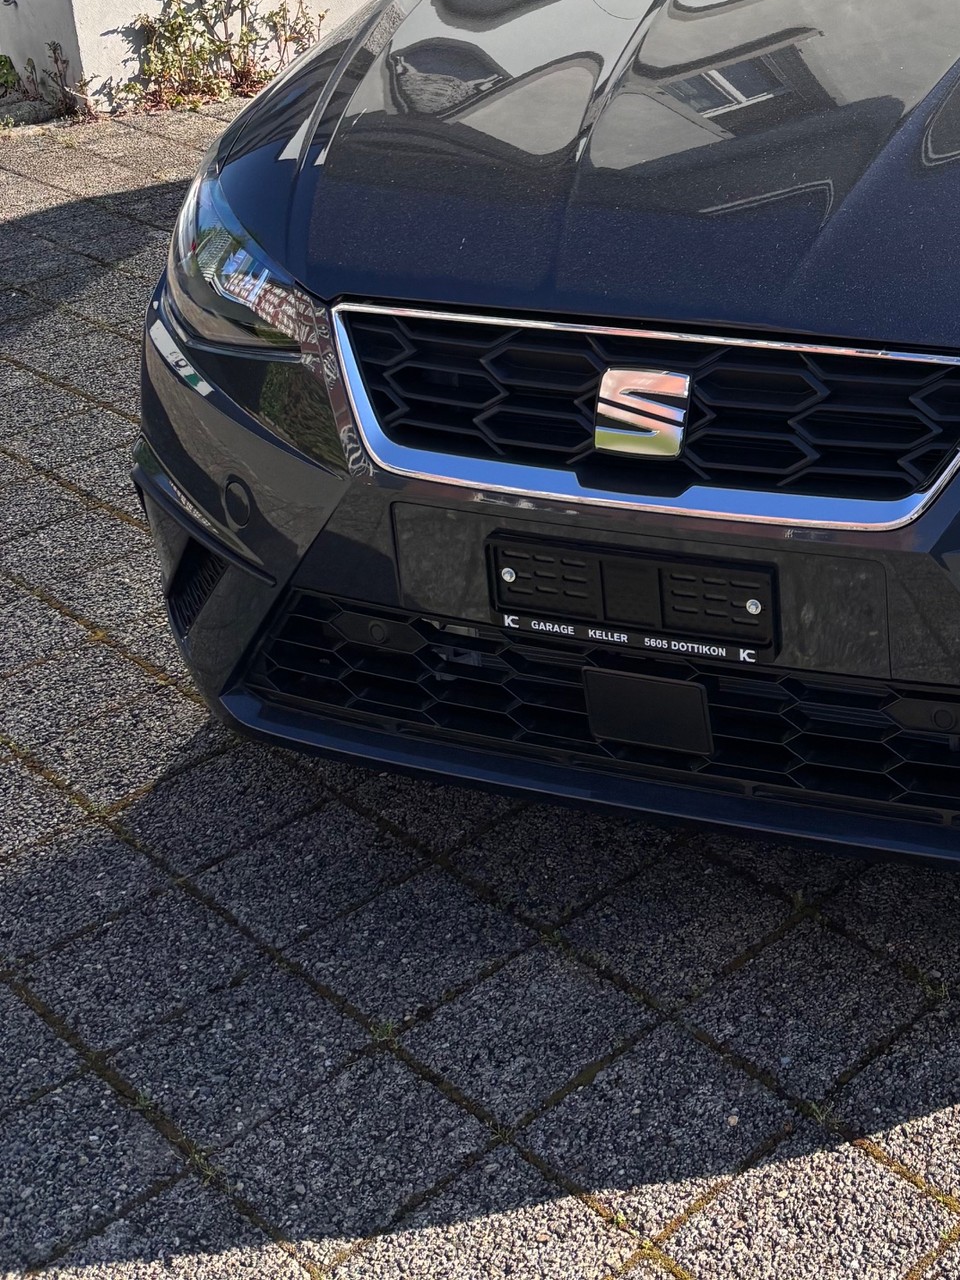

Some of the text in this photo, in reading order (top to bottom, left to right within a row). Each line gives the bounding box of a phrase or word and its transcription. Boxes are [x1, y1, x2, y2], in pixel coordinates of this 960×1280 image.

[531, 620, 575, 635] GARAGE
[588, 629, 628, 643] KELLER
[644, 637, 668, 649] 5605
[671, 641, 726, 657] DOTTIKON
